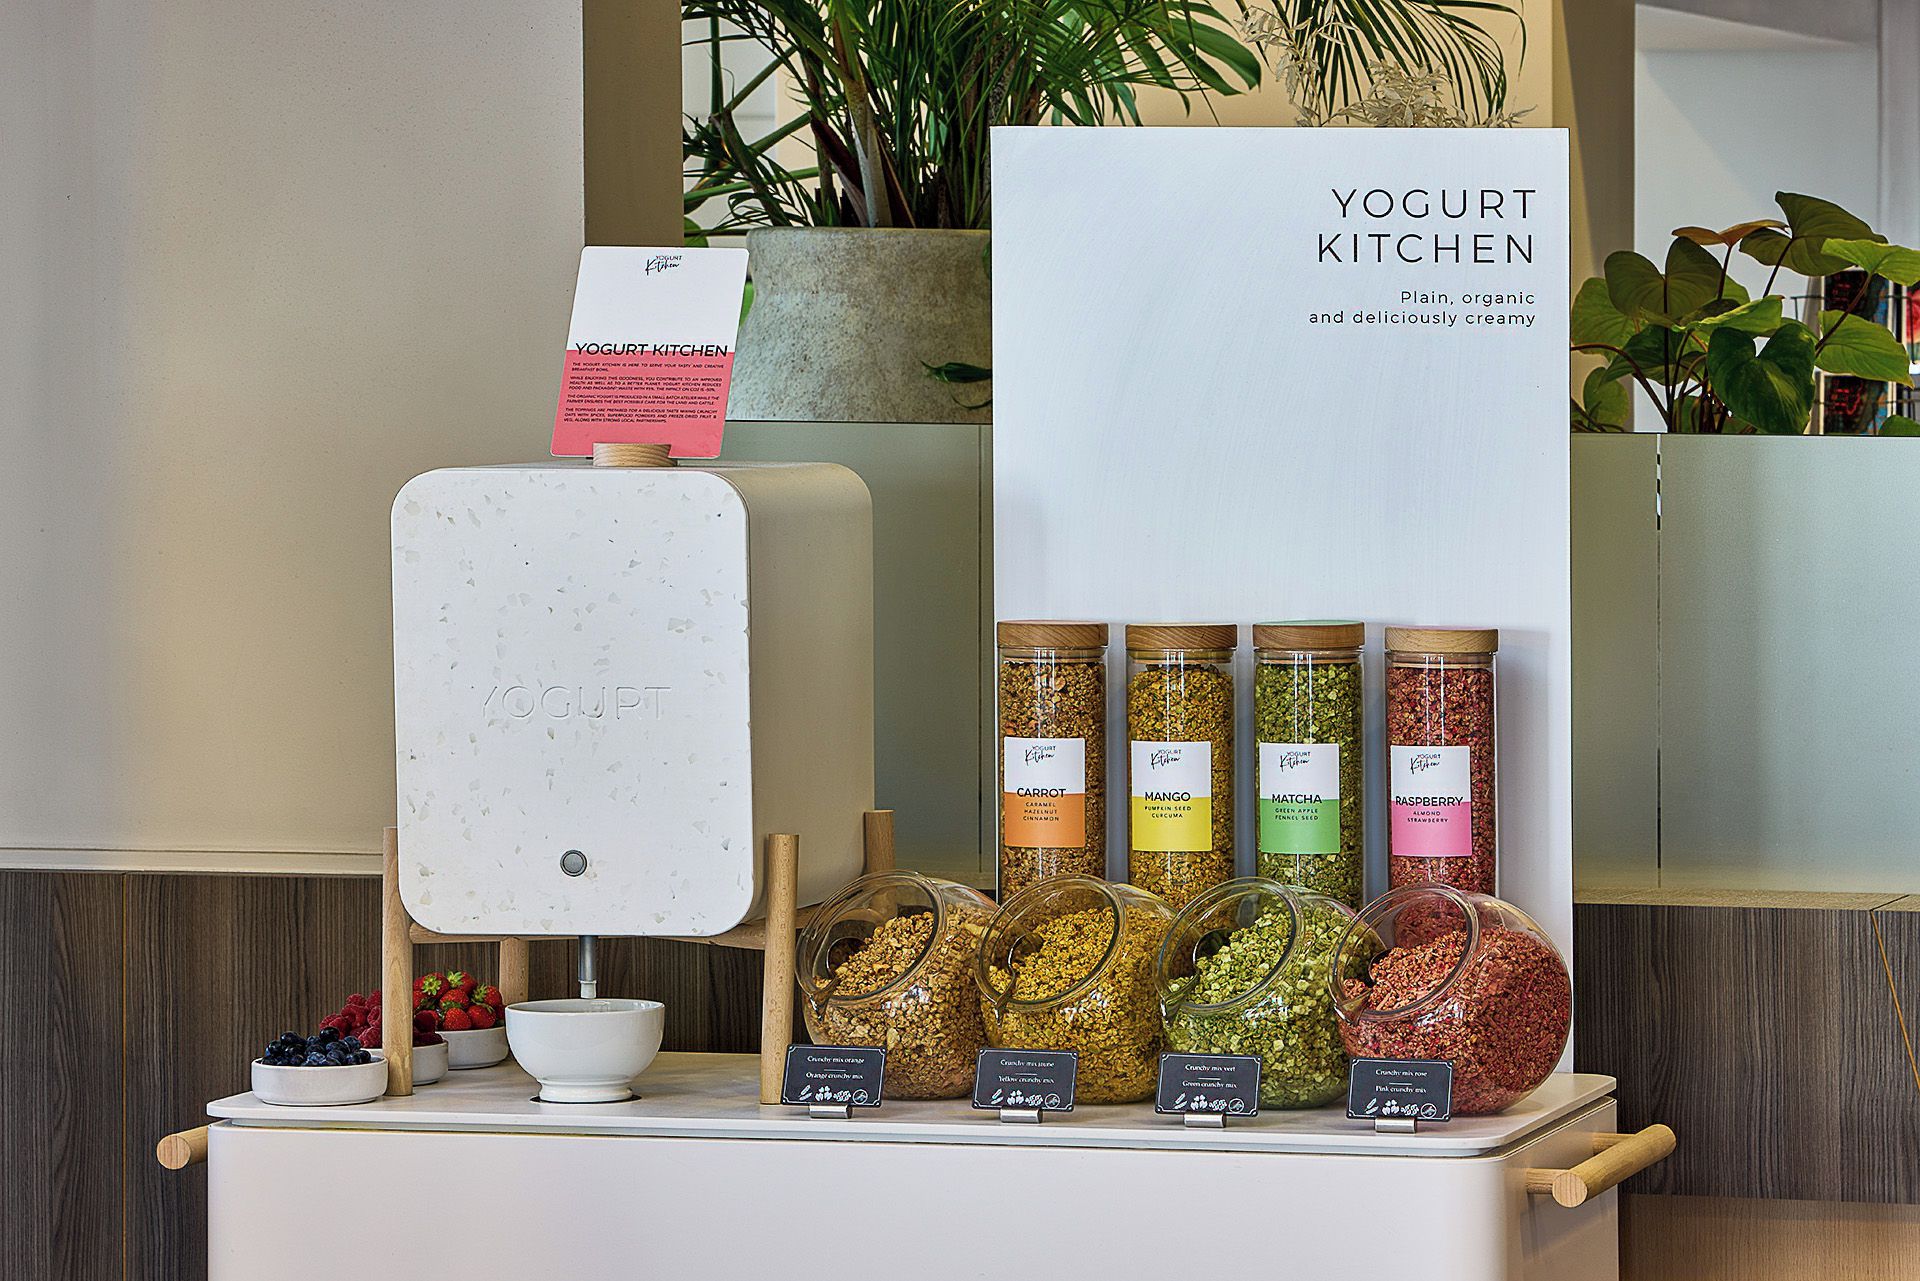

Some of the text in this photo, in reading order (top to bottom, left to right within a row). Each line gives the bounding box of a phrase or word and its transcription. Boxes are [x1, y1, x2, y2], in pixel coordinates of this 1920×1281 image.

[1331, 189, 1536, 219] YOGURT
[1318, 233, 1532, 264] KITCHEN
[1401, 291, 1535, 307] Plain, organic
[1309, 310, 1536, 327] and deliciously creamy
[575, 342, 728, 357] YOGURT KITCHEN
[471, 685, 672, 720] YOGURT
[1016, 788, 1066, 798] CARROT
[1144, 792, 1191, 802] MANGO
[1271, 794, 1322, 804] MATCHA
[1395, 796, 1463, 807] RASPBERRY
[1000, 1059, 1024, 1067] Crunchy
[1185, 1064, 1210, 1072] Crunchy
